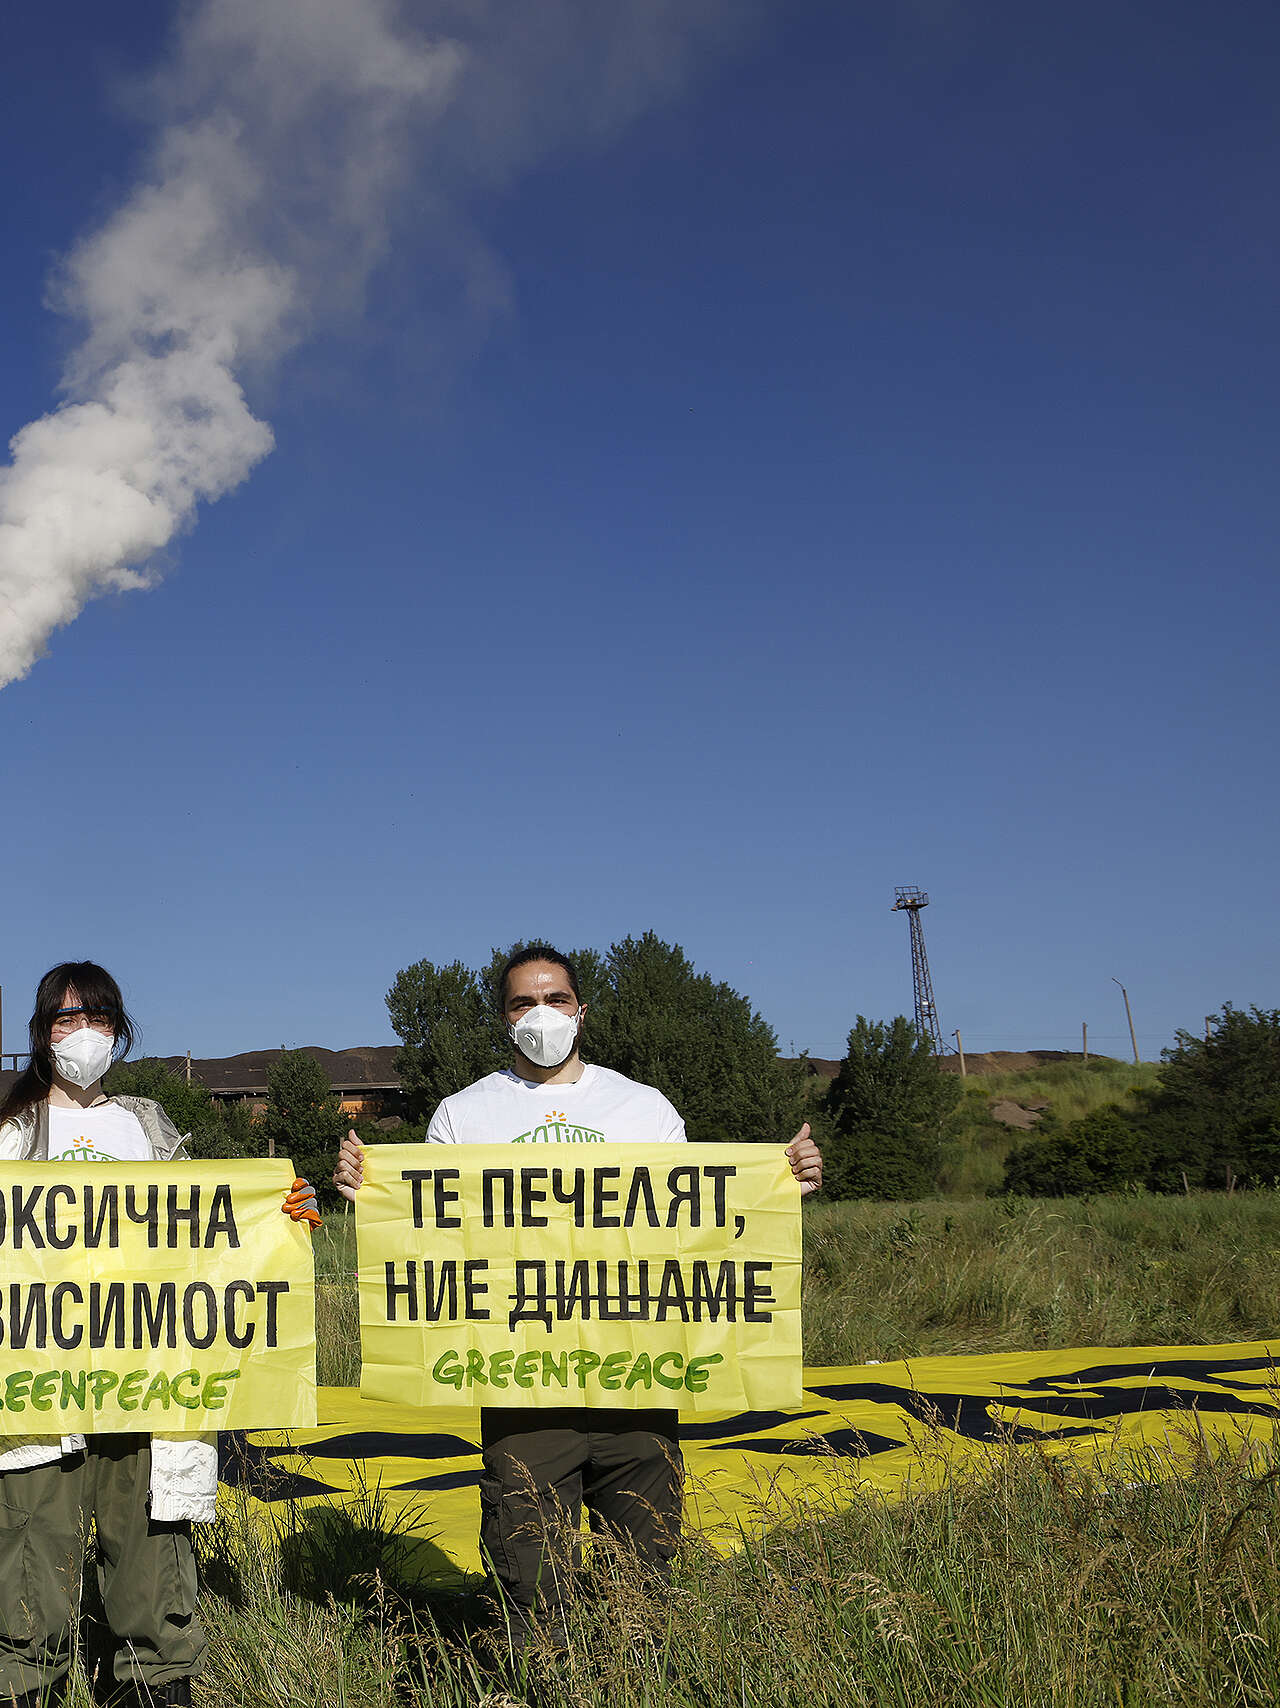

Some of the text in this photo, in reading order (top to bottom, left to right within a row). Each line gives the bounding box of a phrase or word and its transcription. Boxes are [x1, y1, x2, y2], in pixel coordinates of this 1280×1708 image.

[402, 1166, 745, 1239] ТЕ ПЕЧЕЛЯТ,
[385, 1259, 776, 1333] НИЕ ДИШАМЕ
[433, 1350, 723, 1393] GREENPEACE
